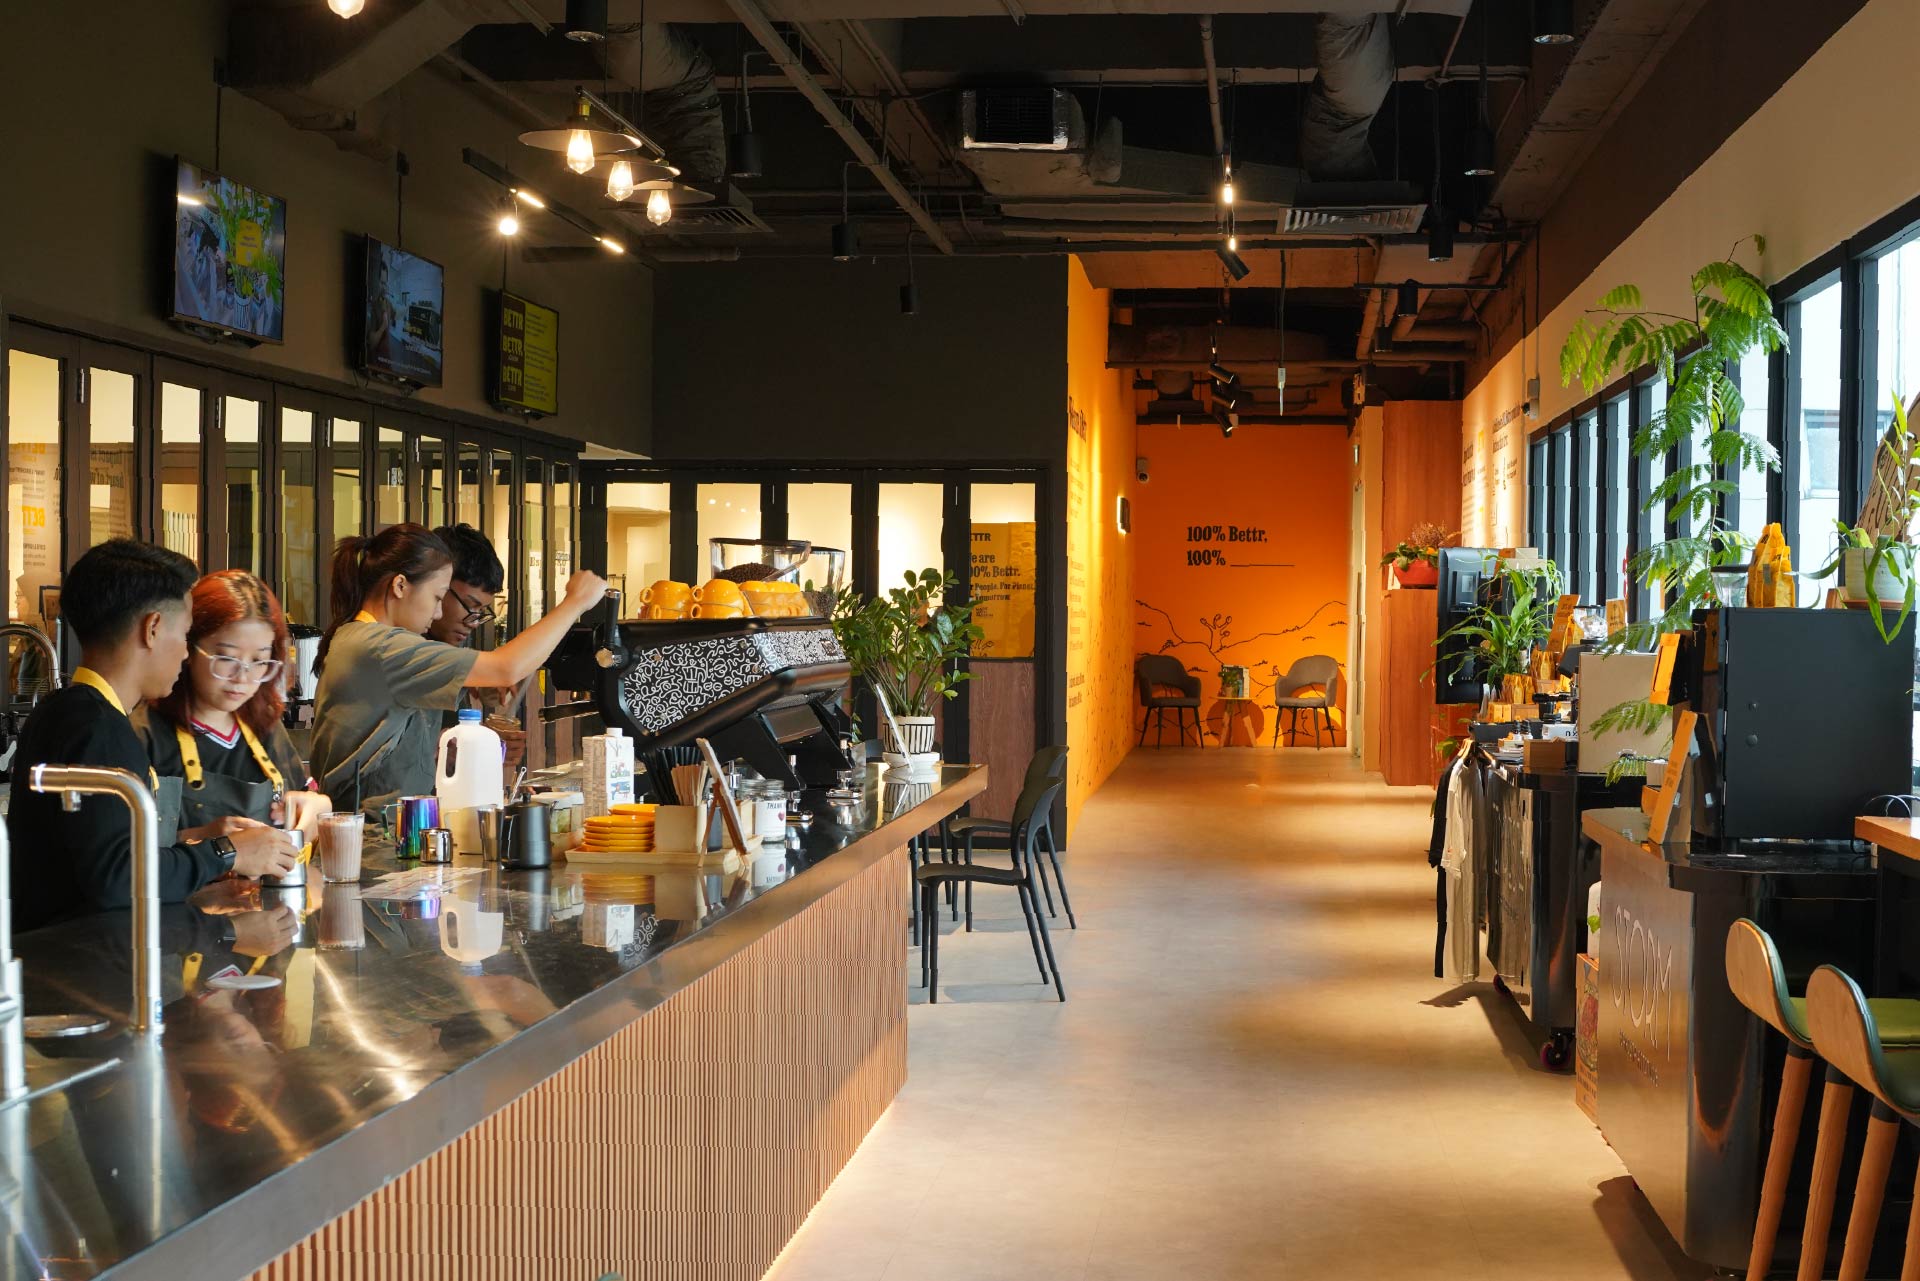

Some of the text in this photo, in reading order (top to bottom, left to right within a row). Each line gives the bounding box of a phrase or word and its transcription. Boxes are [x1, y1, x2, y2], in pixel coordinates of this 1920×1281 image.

[503, 308, 523, 330] BETTR
[503, 335, 523, 356] BETTR
[503, 366, 522, 386] BETTR
[1187, 525, 1226, 542] 100%
[979, 554, 996, 563] are
[1187, 550, 1226, 566] 100%
[992, 566, 1021, 578] Bettr.
[1000, 581, 1012, 590] For
[1612, 904, 1672, 1062] STORM
